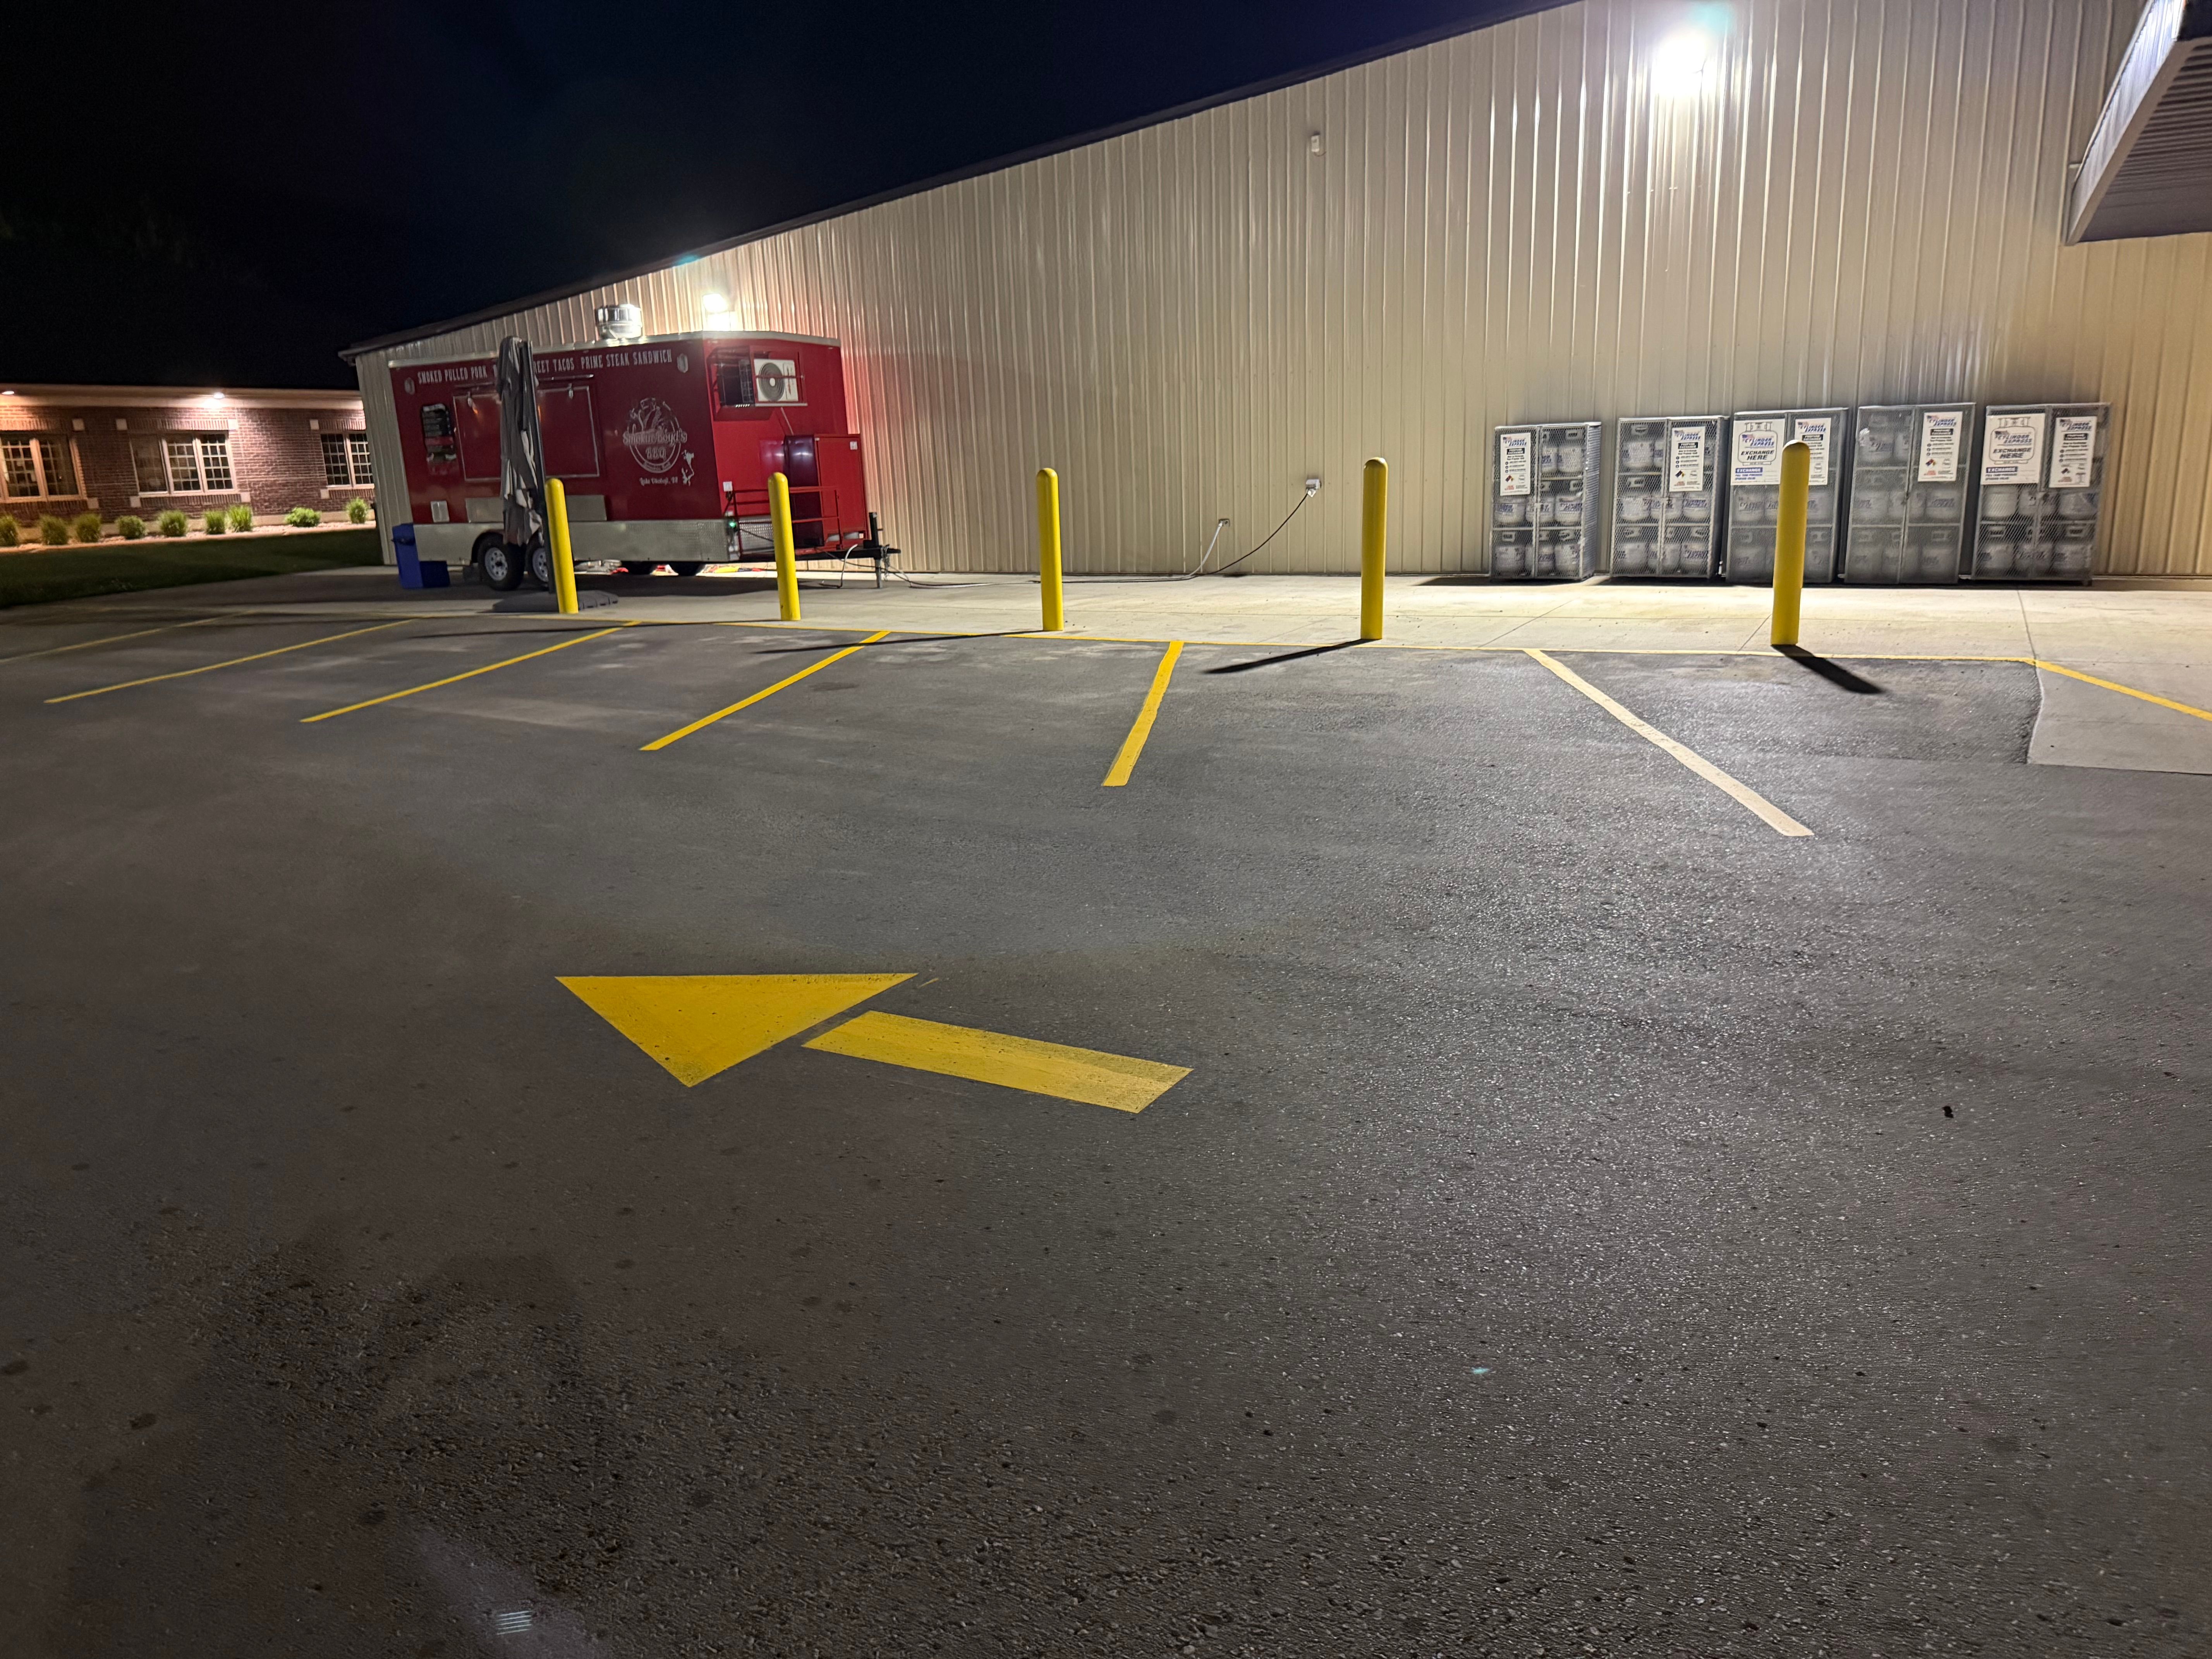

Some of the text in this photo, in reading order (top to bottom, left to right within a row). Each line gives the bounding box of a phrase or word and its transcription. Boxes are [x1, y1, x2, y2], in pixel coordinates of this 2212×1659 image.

[417, 369, 442, 385] SMOKED
[444, 367, 468, 381] PULLED
[471, 365, 487, 380] PORK
[533, 360, 549, 374] REET
[553, 357, 574, 372] TACOS
[581, 355, 603, 369] PRIME
[606, 352, 629, 367] STEAK
[632, 349, 672, 365] SANDWICH
